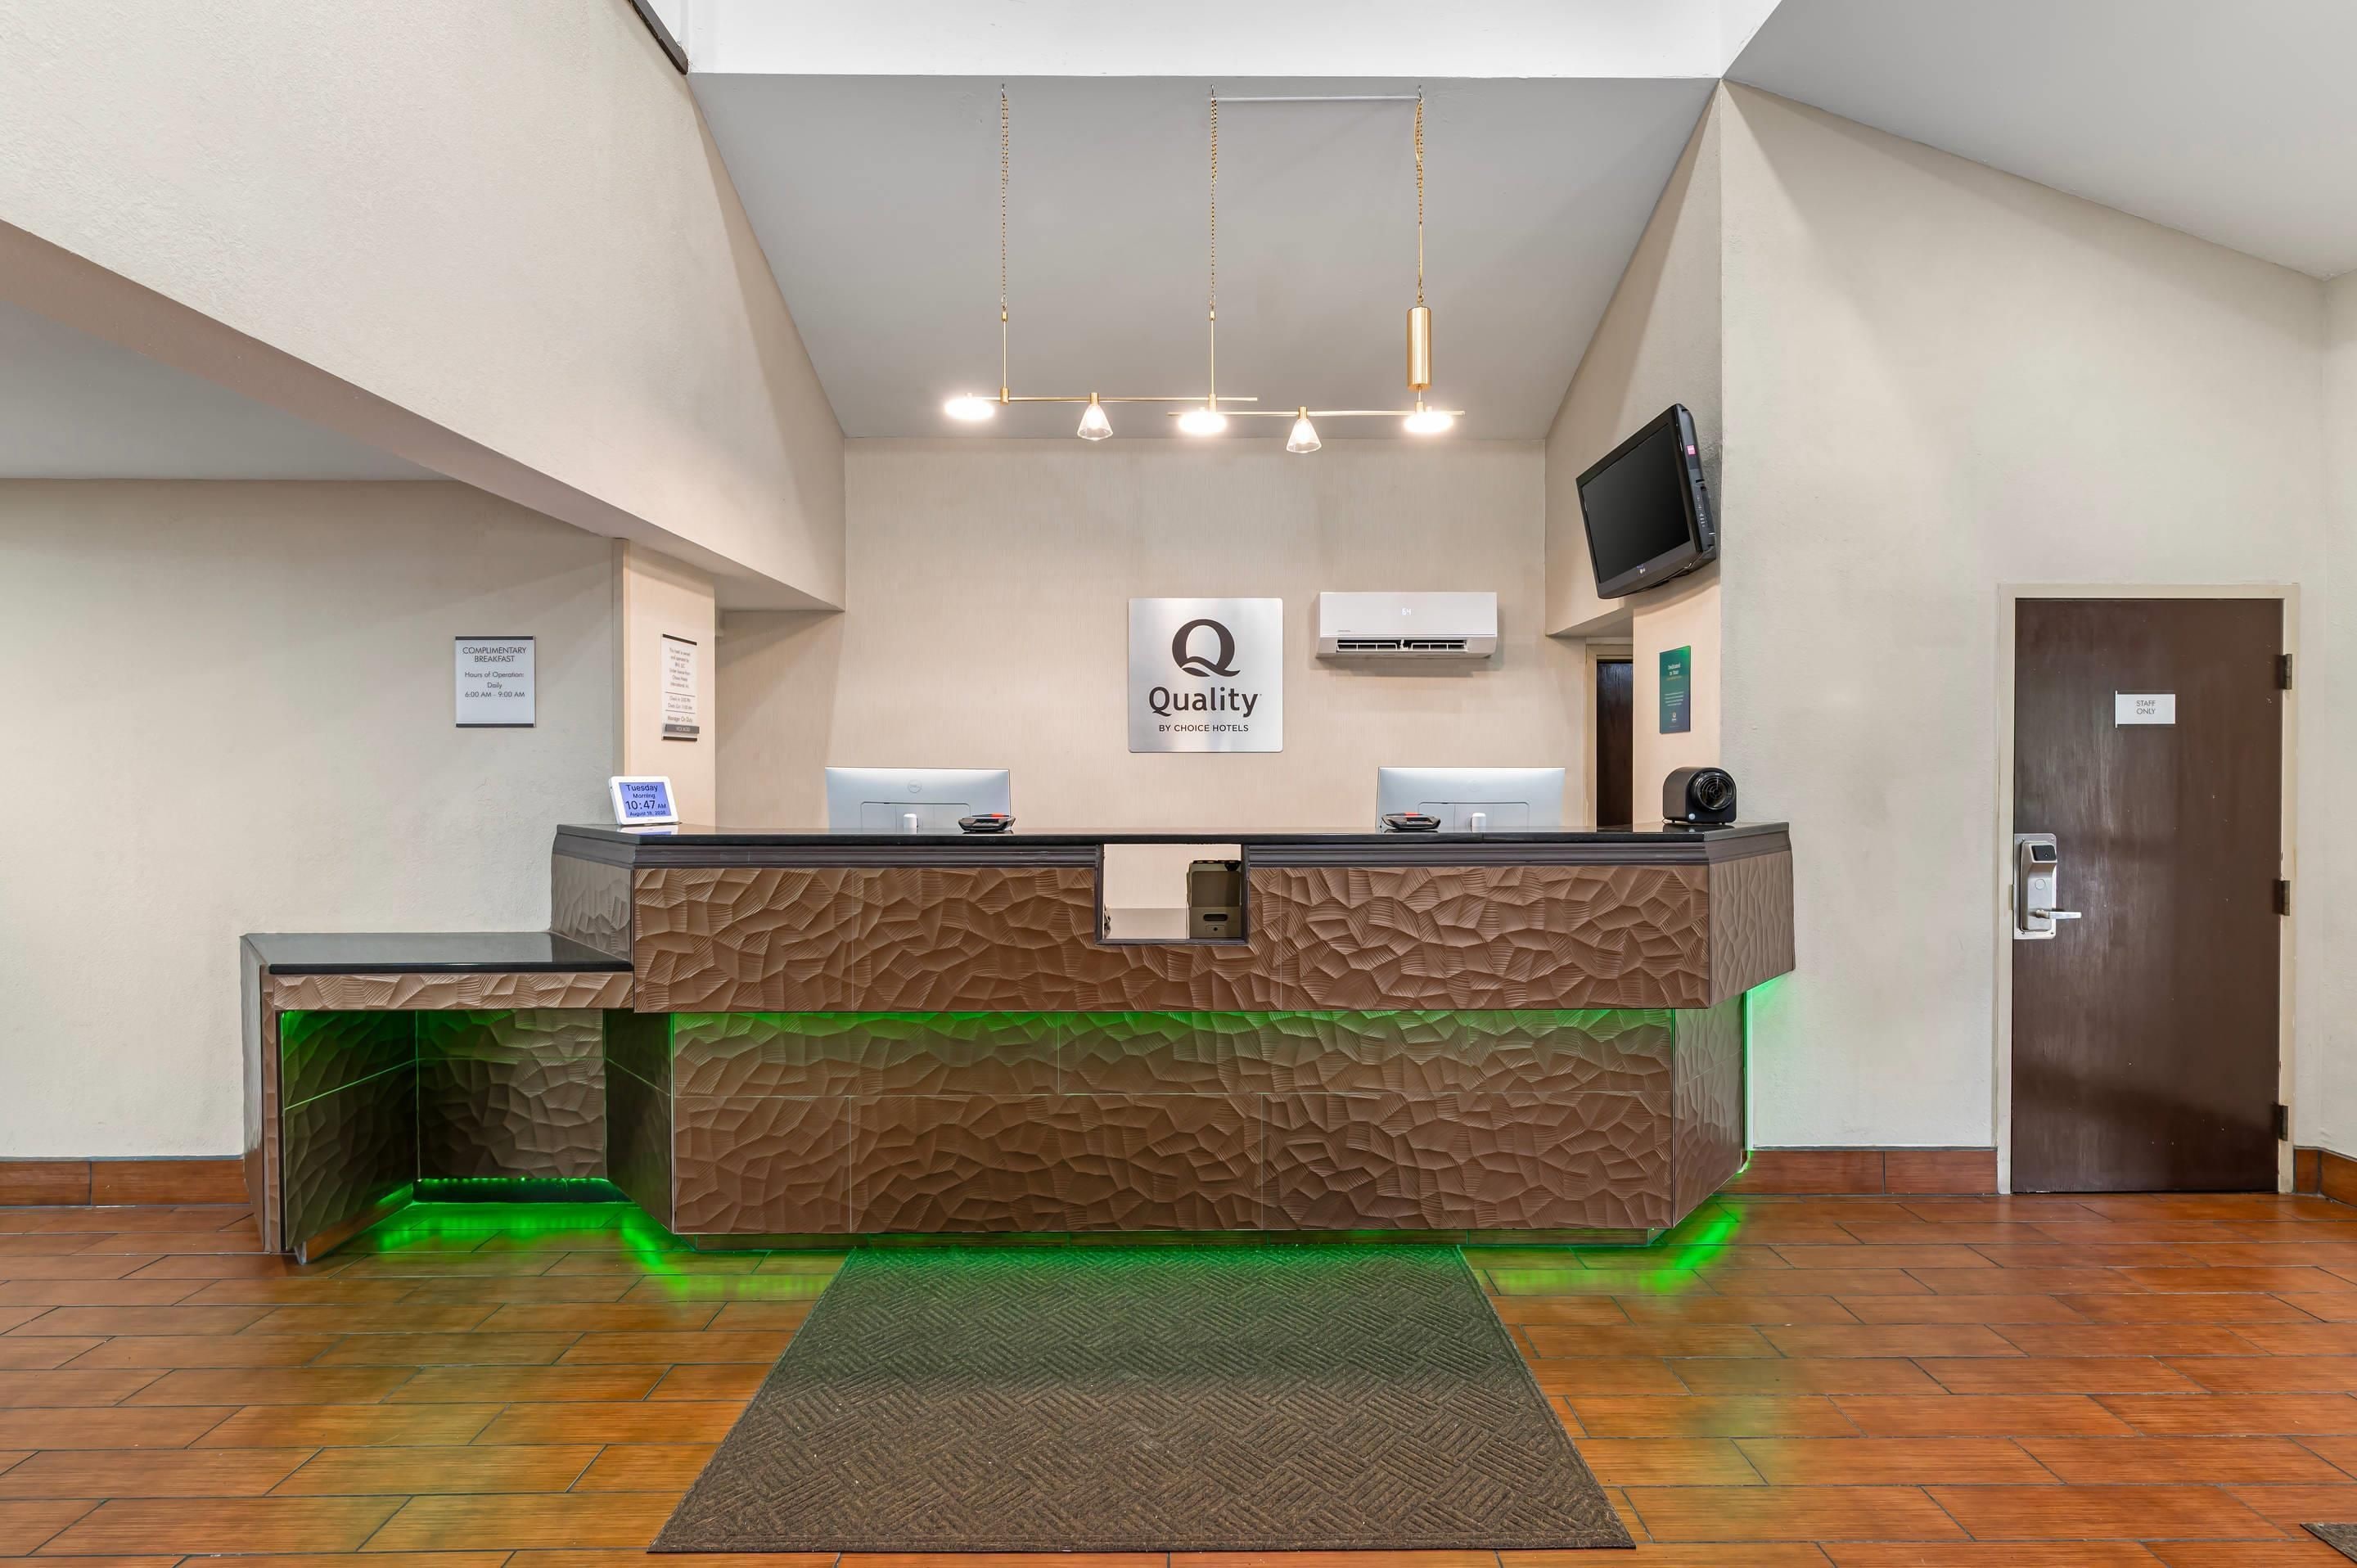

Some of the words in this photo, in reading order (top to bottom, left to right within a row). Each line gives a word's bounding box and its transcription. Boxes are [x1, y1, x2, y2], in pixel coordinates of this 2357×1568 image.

[462, 647, 527, 655] COMPLIMENTARY
[1172, 619, 1241, 677] Q
[474, 655, 516, 663] BREAKFAST
[1149, 686, 1259, 718] Quality
[625, 784, 658, 792] Tuesday
[625, 800, 655, 810] 10:47
